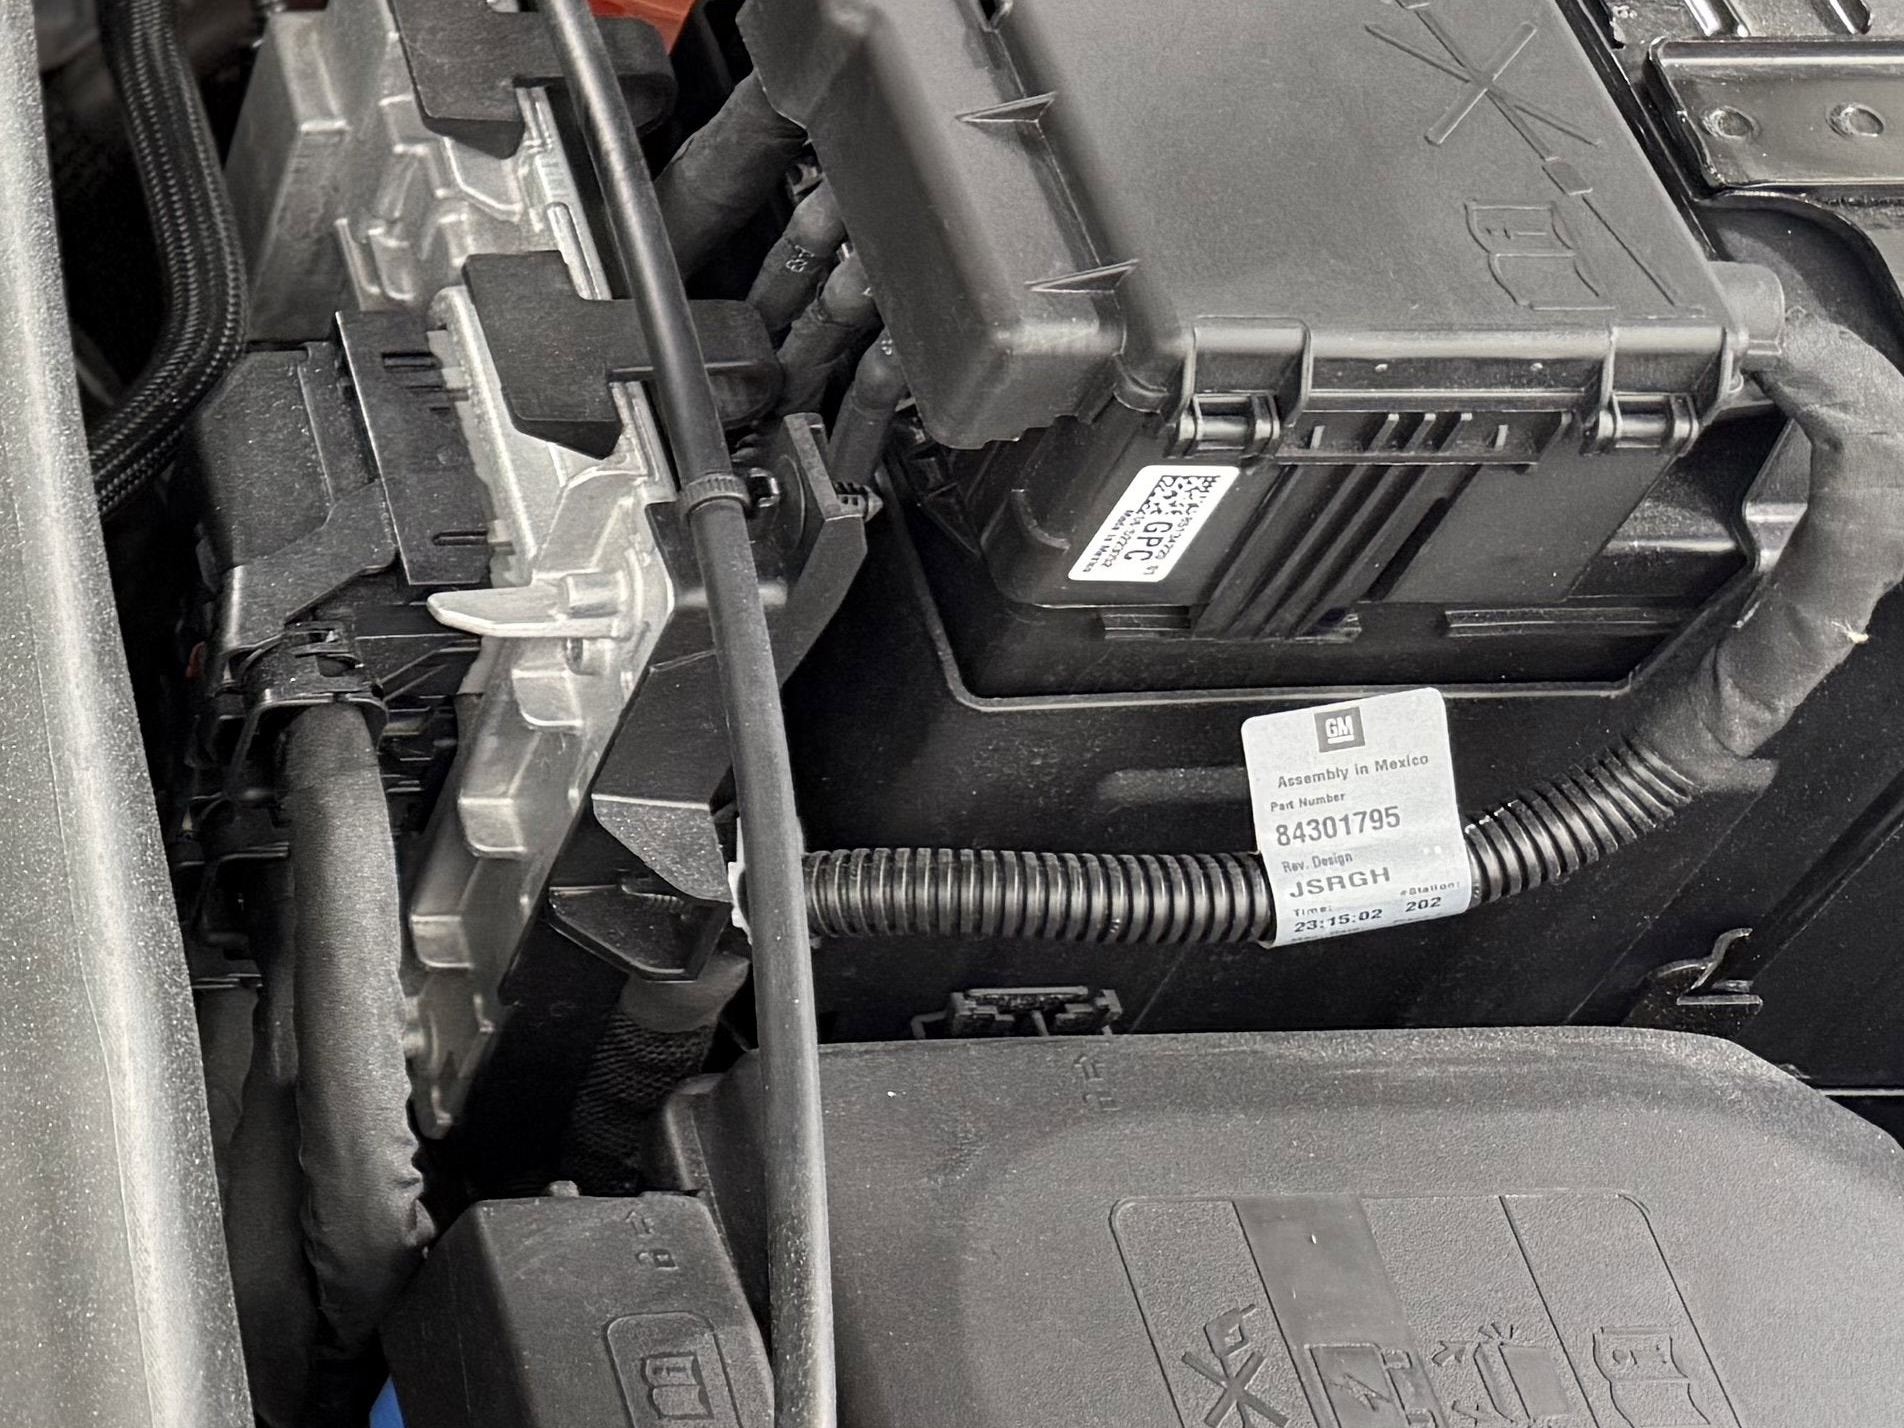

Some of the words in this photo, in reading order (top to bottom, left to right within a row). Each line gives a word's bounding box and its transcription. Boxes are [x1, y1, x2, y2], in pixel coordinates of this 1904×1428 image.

[1124, 521, 1173, 561] GPC
[1325, 714, 1354, 744] GM
[1278, 767, 1349, 788] Assembly
[1355, 762, 1369, 776] in
[1375, 754, 1429, 773] Mexico
[1270, 798, 1294, 813] Part
[1299, 791, 1345, 808] Number
[1275, 805, 1401, 847] 84301795
[1281, 859, 1309, 874] Rev.
[1312, 852, 1353, 870] Design
[1289, 866, 1392, 899] JSRGH
[1293, 905, 1333, 918] Time:
[1405, 896, 1442, 913] 202
[1294, 908, 1383, 933] 23:15:02
